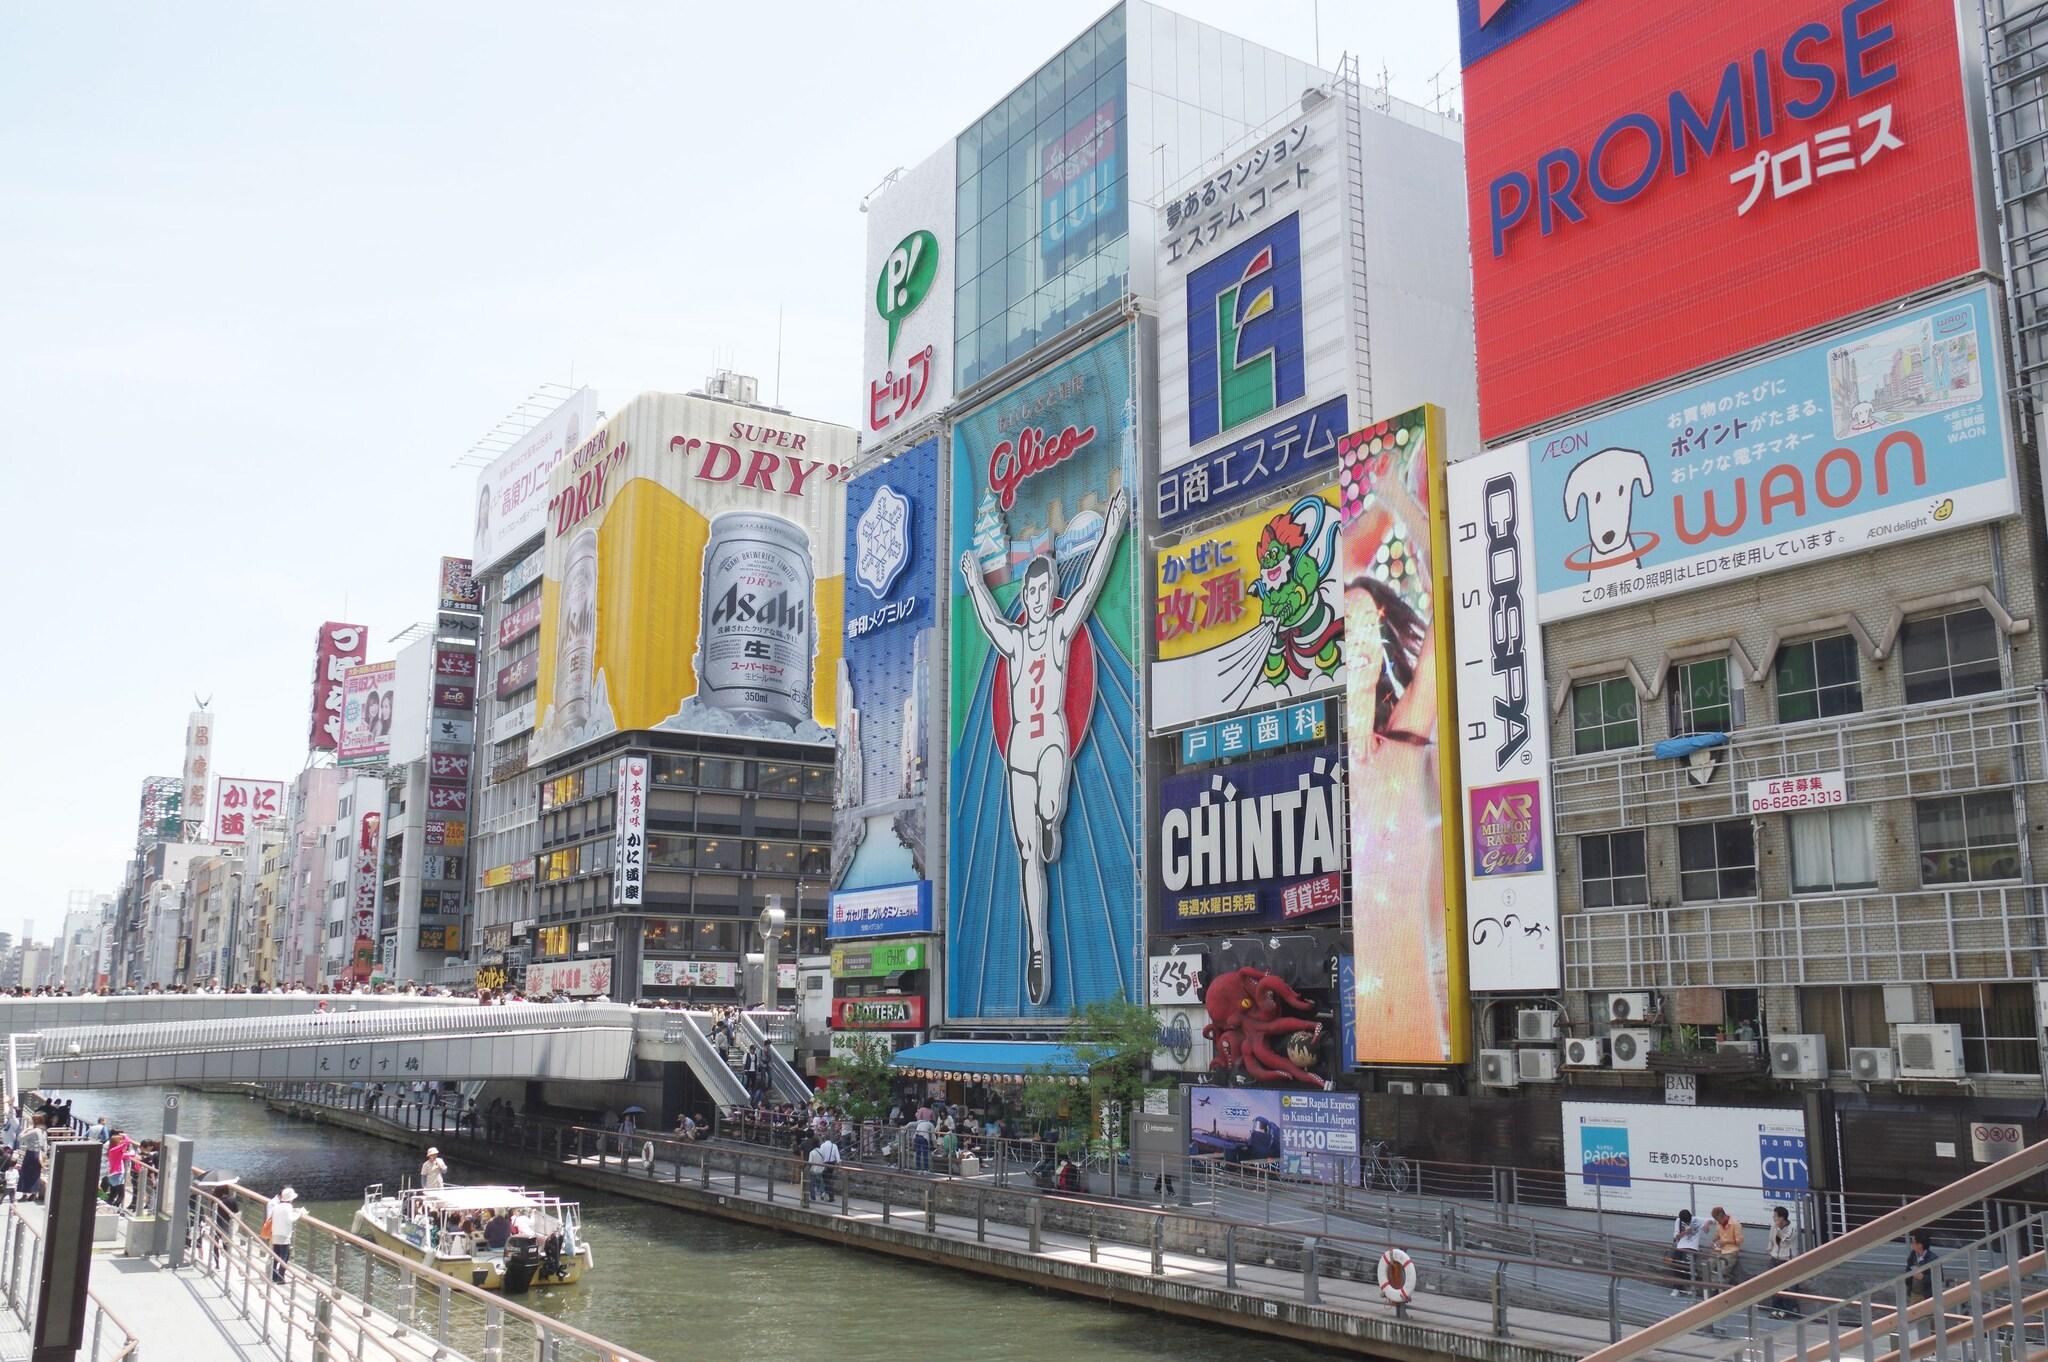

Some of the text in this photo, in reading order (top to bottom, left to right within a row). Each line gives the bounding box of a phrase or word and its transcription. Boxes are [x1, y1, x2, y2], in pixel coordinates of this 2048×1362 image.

[1490, 0, 1897, 258] PROMISE
[1166, 124, 1309, 232] 夢あるマンション
[1730, 103, 1905, 217] プロミス
[1167, 164, 1312, 265] エステムコート
[870, 343, 935, 432] ピップ
[1666, 377, 1786, 430] お買物のたびに
[572, 429, 607, 473] SUPER
[730, 421, 807, 451] SUPER
[1947, 425, 1986, 444] WAON
[988, 425, 1096, 511] Glico
[1157, 418, 1336, 521] 日商エステム
[1671, 431, 1816, 485] おトクな電子マネー
[1161, 538, 1235, 585] かぜに
[1581, 532, 1847, 605] この看板の照明はLEDを使用しています。
[712, 582, 804, 635] Asahi
[847, 596, 915, 640] 雪印メグミルク
[1156, 566, 1247, 642] 改源
[1483, 471, 1530, 772] COSPA
[744, 640, 772, 660] 生
[1458, 521, 1487, 742] ASIA
[731, 662, 785, 677] スーパードライ
[745, 691, 769, 704] 350ml
[1027, 653, 1046, 739] グリコ
[1188, 704, 1317, 761] 戸堂歯科
[1752, 790, 1843, 813] 06-6262-1313
[1768, 776, 1823, 796] 広告募集
[1482, 818, 1532, 837] MILLION
[1487, 833, 1528, 848] RACER
[1178, 892, 1256, 918] 毎週水曜日発売
[319, 1056, 420, 1074] えびす橋
[1666, 1075, 1695, 1091] BAR
[1282, 1112, 1290, 1121] to
[1291, 1111, 1313, 1123] Kansai
[1330, 1113, 1356, 1128] Airport
[1309, 1096, 1329, 1112] Rapid
[1330, 1097, 1356, 1113] Express
[1649, 1152, 1739, 1173] 圧巻の520shops
